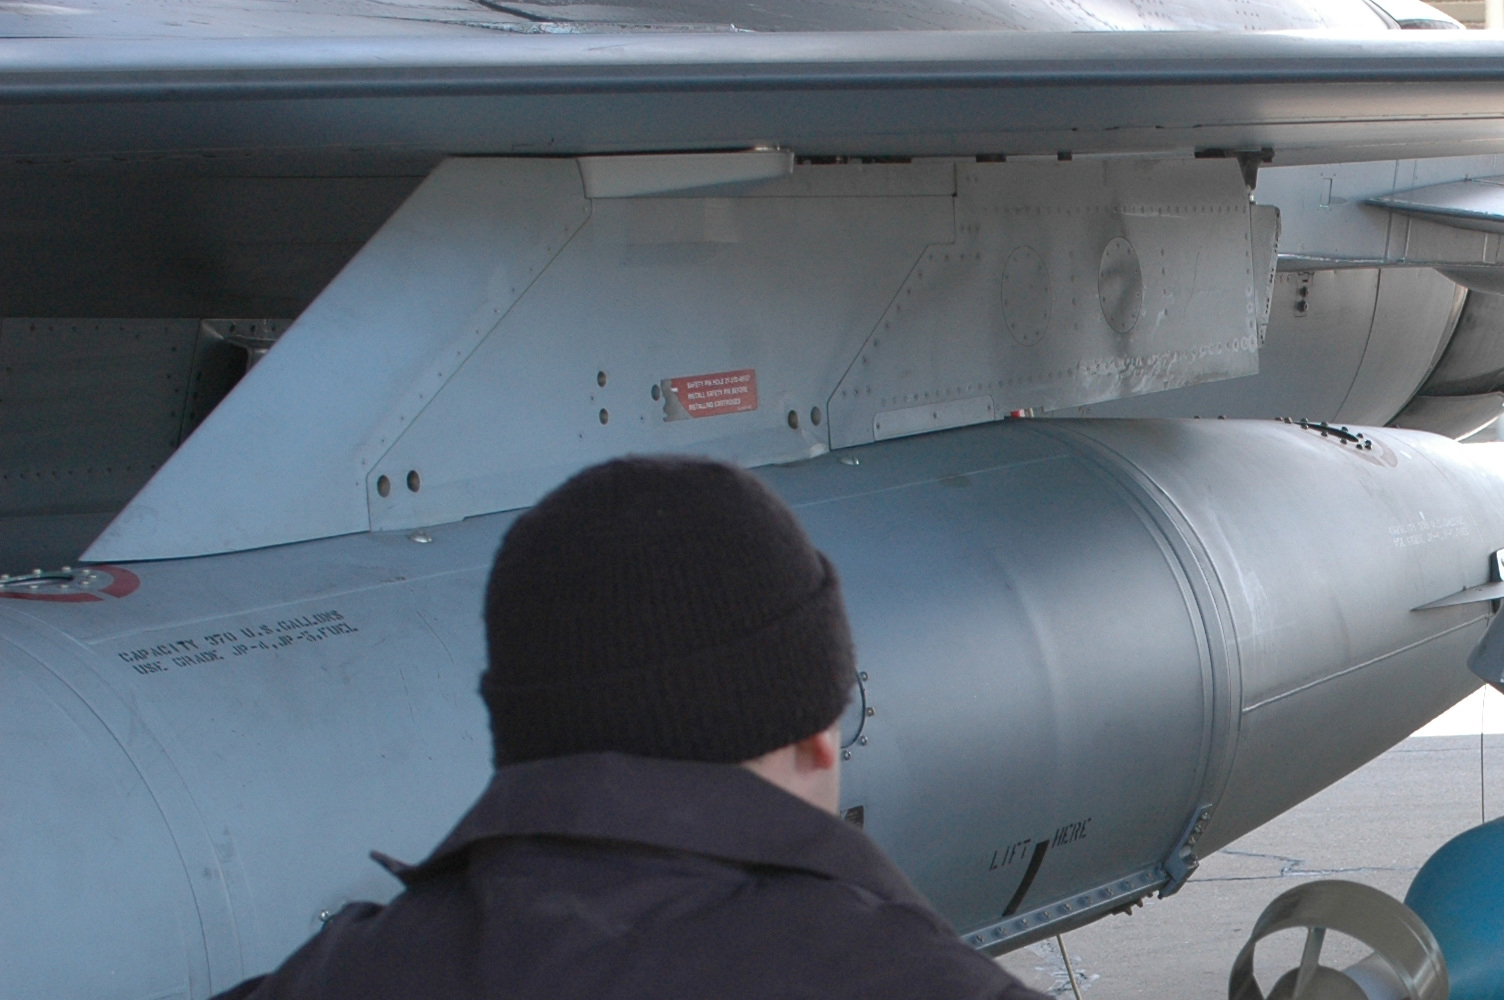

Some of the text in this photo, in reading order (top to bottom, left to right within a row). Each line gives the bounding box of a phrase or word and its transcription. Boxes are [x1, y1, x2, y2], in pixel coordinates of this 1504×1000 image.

[118, 639, 200, 663] CAPACITY
[204, 631, 237, 647] 370
[132, 661, 169, 675] USE
[172, 650, 224, 667] GRADE
[989, 817, 1092, 872] LIFT HERE
